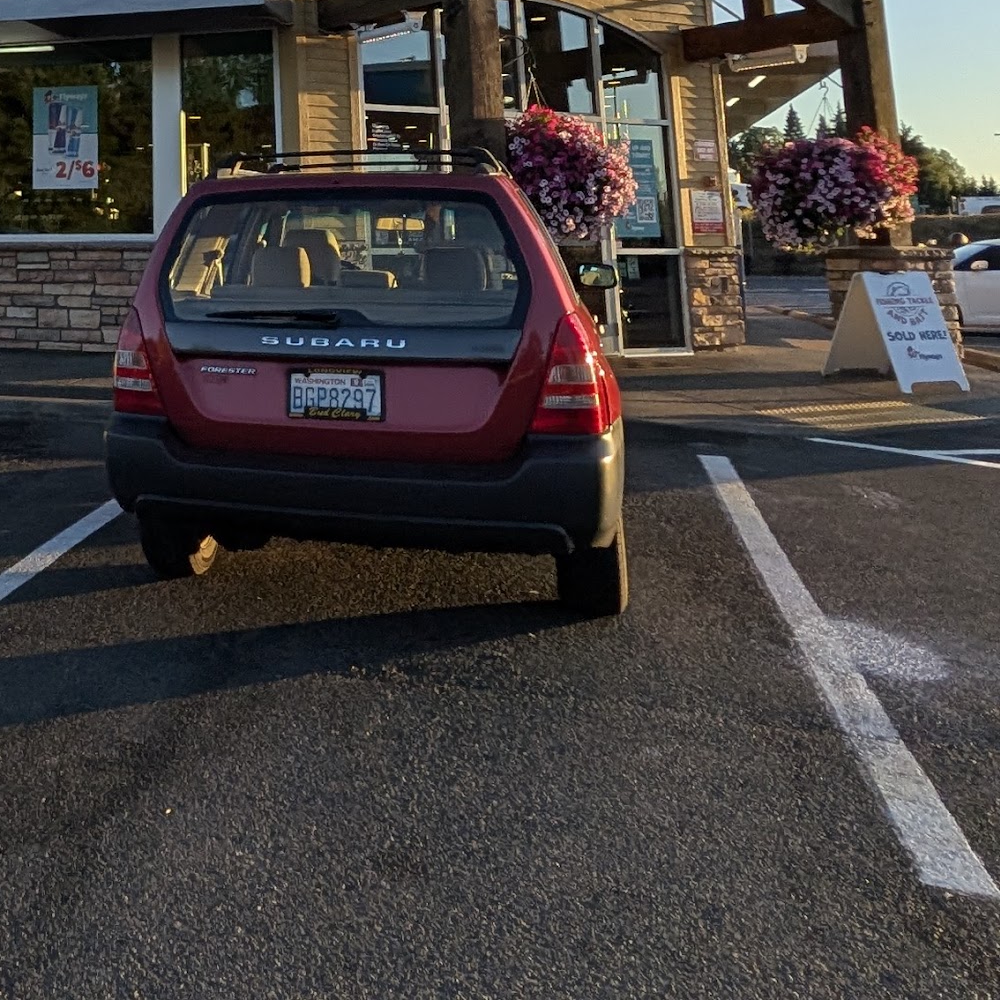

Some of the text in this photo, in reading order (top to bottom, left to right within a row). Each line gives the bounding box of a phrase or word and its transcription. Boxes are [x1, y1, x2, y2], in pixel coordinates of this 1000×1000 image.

[55, 160, 95, 180] 2/$6
[887, 330, 947, 342] SOLD HERE!
[261, 336, 406, 349] SUBARU
[200, 366, 257, 375] FORESTER
[295, 377, 346, 386] WASHINGTON
[293, 386, 377, 413] BGP8297
